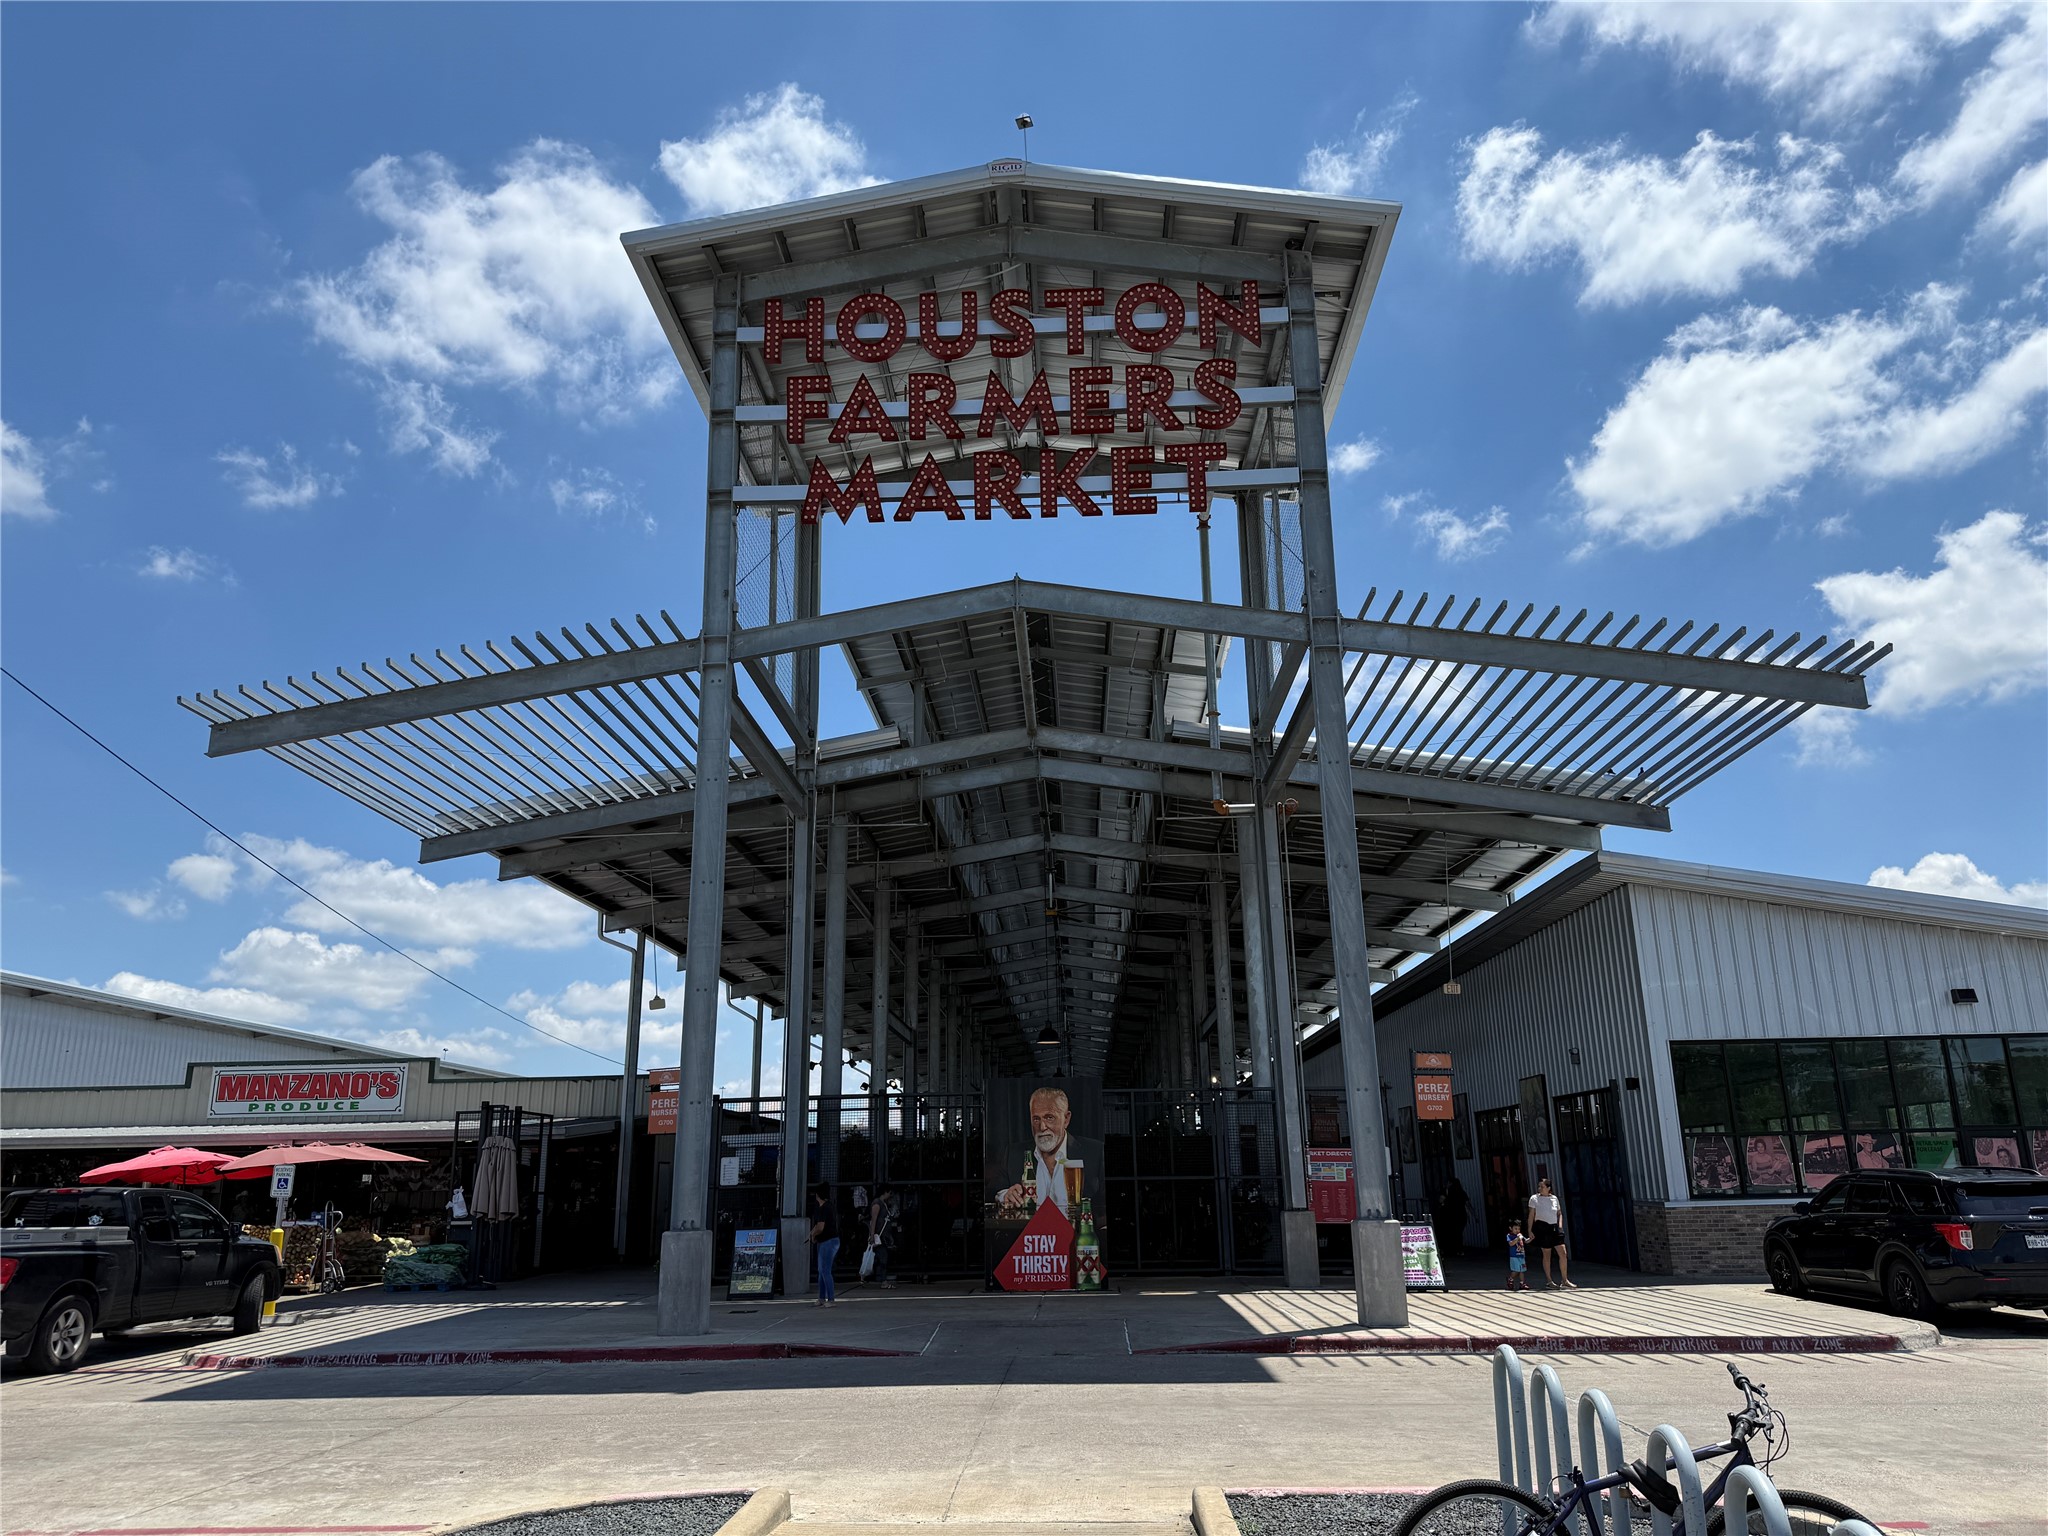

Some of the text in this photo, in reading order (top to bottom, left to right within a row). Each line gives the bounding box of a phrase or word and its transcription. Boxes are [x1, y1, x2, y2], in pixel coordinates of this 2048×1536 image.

[764, 280, 1262, 364] HOUSTON
[786, 358, 1242, 444] FARMERS
[801, 441, 1227, 525] MARKET
[216, 1071, 401, 1102] MANZANO'S
[1417, 1083, 1449, 1093] PEREZ
[1418, 1093, 1450, 1101] NURSERY
[248, 1101, 361, 1112] PRODUCE
[651, 1109, 677, 1117] NURSER
[1023, 1234, 1057, 1254] STAY
[1012, 1255, 1068, 1274] THIRSTY
[1013, 1274, 1066, 1284] my FRIENDS
[1535, 1337, 1566, 1352] FIRE
[1573, 1337, 1609, 1352] LANE
[1662, 1337, 1719, 1351] PARKING
[1739, 1337, 1764, 1351] TOW
[1771, 1337, 1805, 1351] AWAY
[1812, 1337, 1846, 1351] ZONE
[215, 1356, 238, 1369] FIRE
[463, 1352, 493, 1364] ZONE
